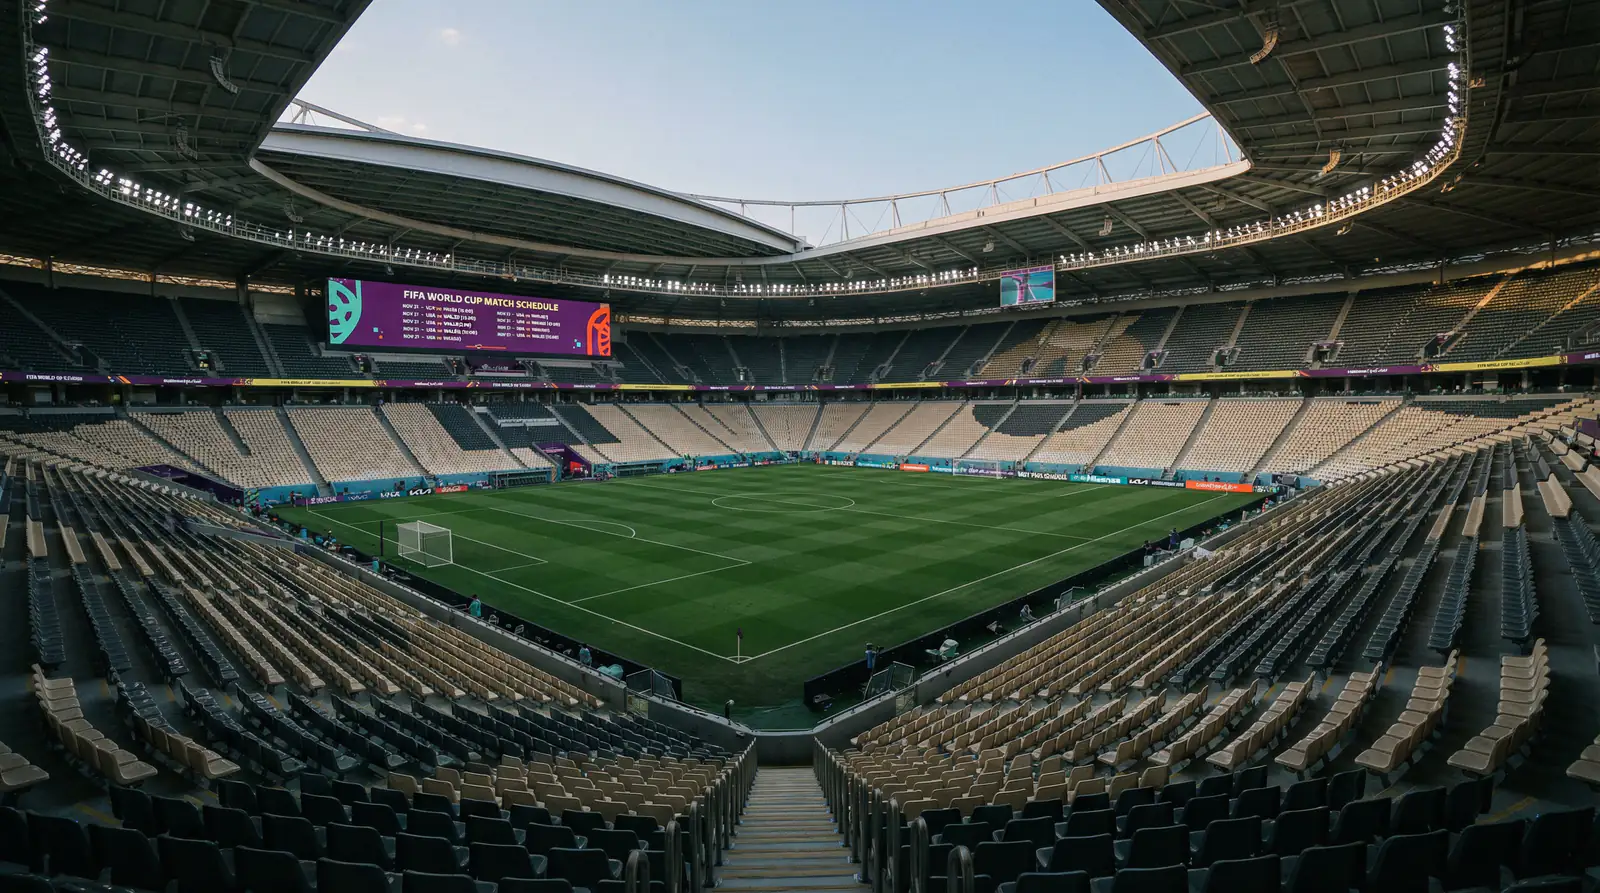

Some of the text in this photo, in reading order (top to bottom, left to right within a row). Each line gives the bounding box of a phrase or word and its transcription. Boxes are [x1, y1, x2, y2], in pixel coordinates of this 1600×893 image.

[403, 290, 559, 311] FIFA WORLD CUP MATCH SCHEDULE
